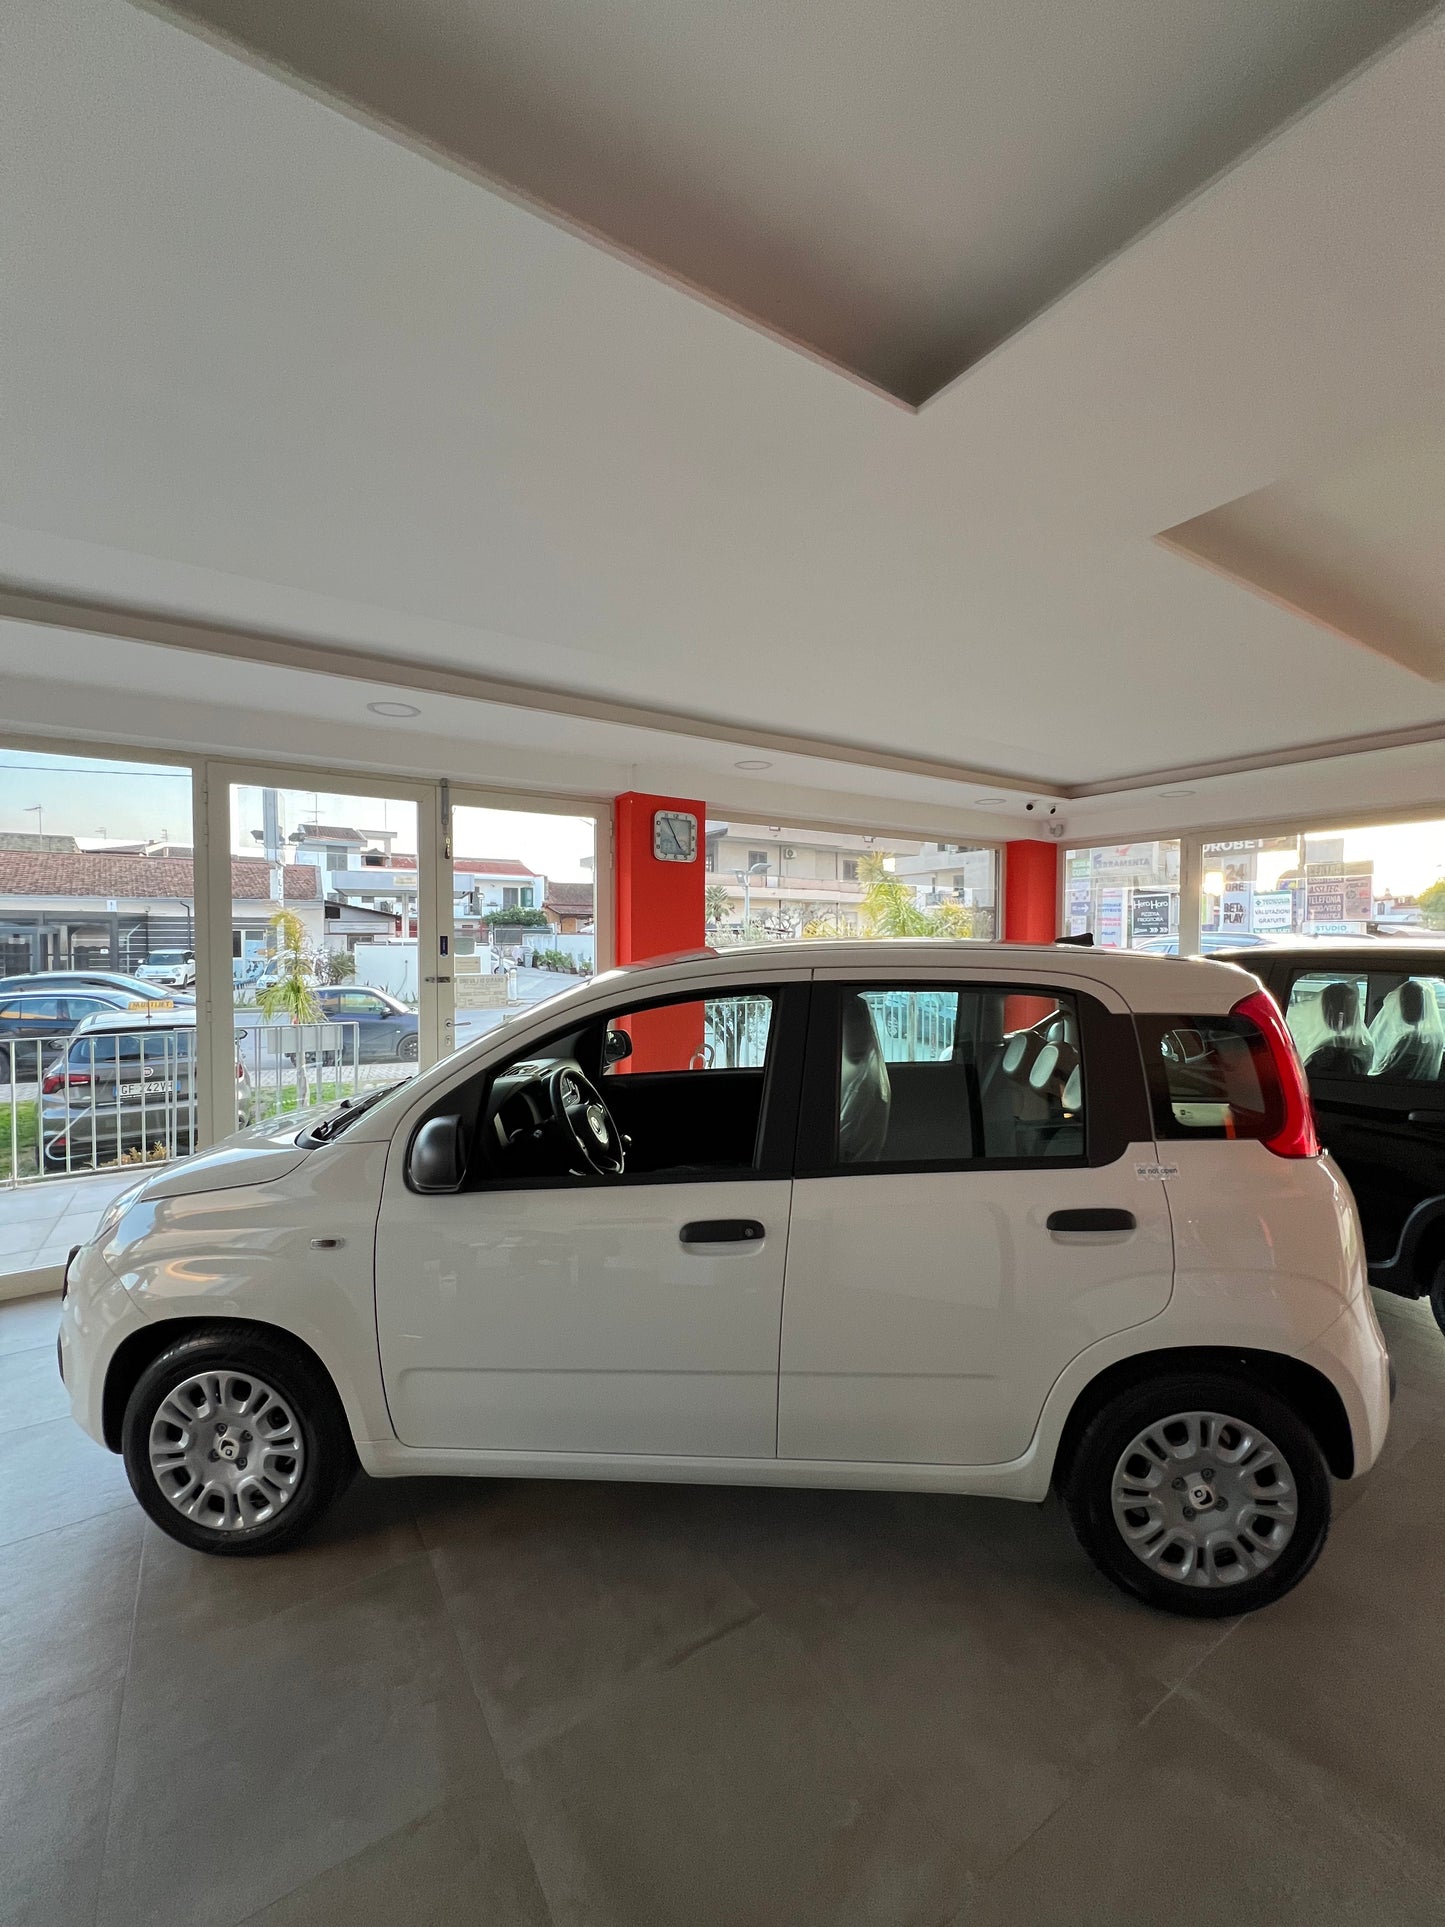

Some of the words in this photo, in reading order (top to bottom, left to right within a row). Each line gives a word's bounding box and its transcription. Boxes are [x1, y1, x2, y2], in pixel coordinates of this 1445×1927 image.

[1225, 863, 1246, 882] 24
[1225, 882, 1246, 892] ORE
[1309, 895, 1342, 905] TELEFONIA
[1223, 913, 1245, 924] PLAY
[121, 1085, 135, 1095] GF
[140, 1082, 173, 1093] 42VH
